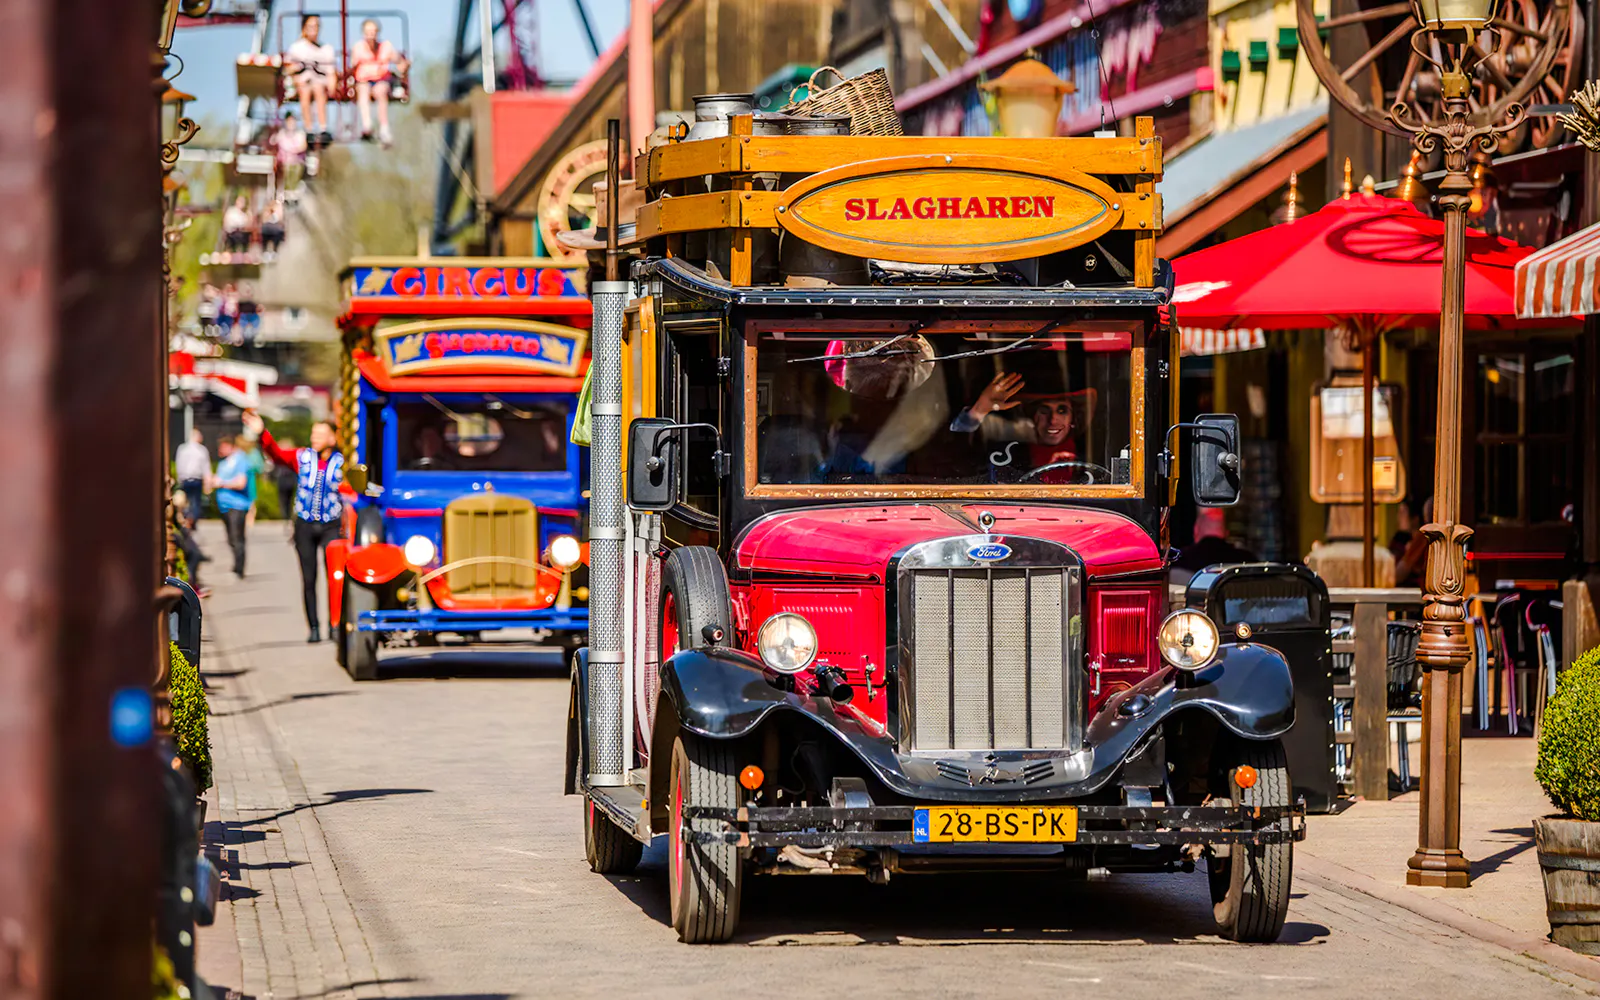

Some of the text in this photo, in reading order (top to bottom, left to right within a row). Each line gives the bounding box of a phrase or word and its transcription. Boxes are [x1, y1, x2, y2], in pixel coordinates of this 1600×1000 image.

[844, 196, 1056, 221] SLAGHAREN
[391, 266, 567, 299] CIRCUS
[976, 546, 1002, 557] Ford
[916, 813, 1066, 836] NL 28-BS-PK
